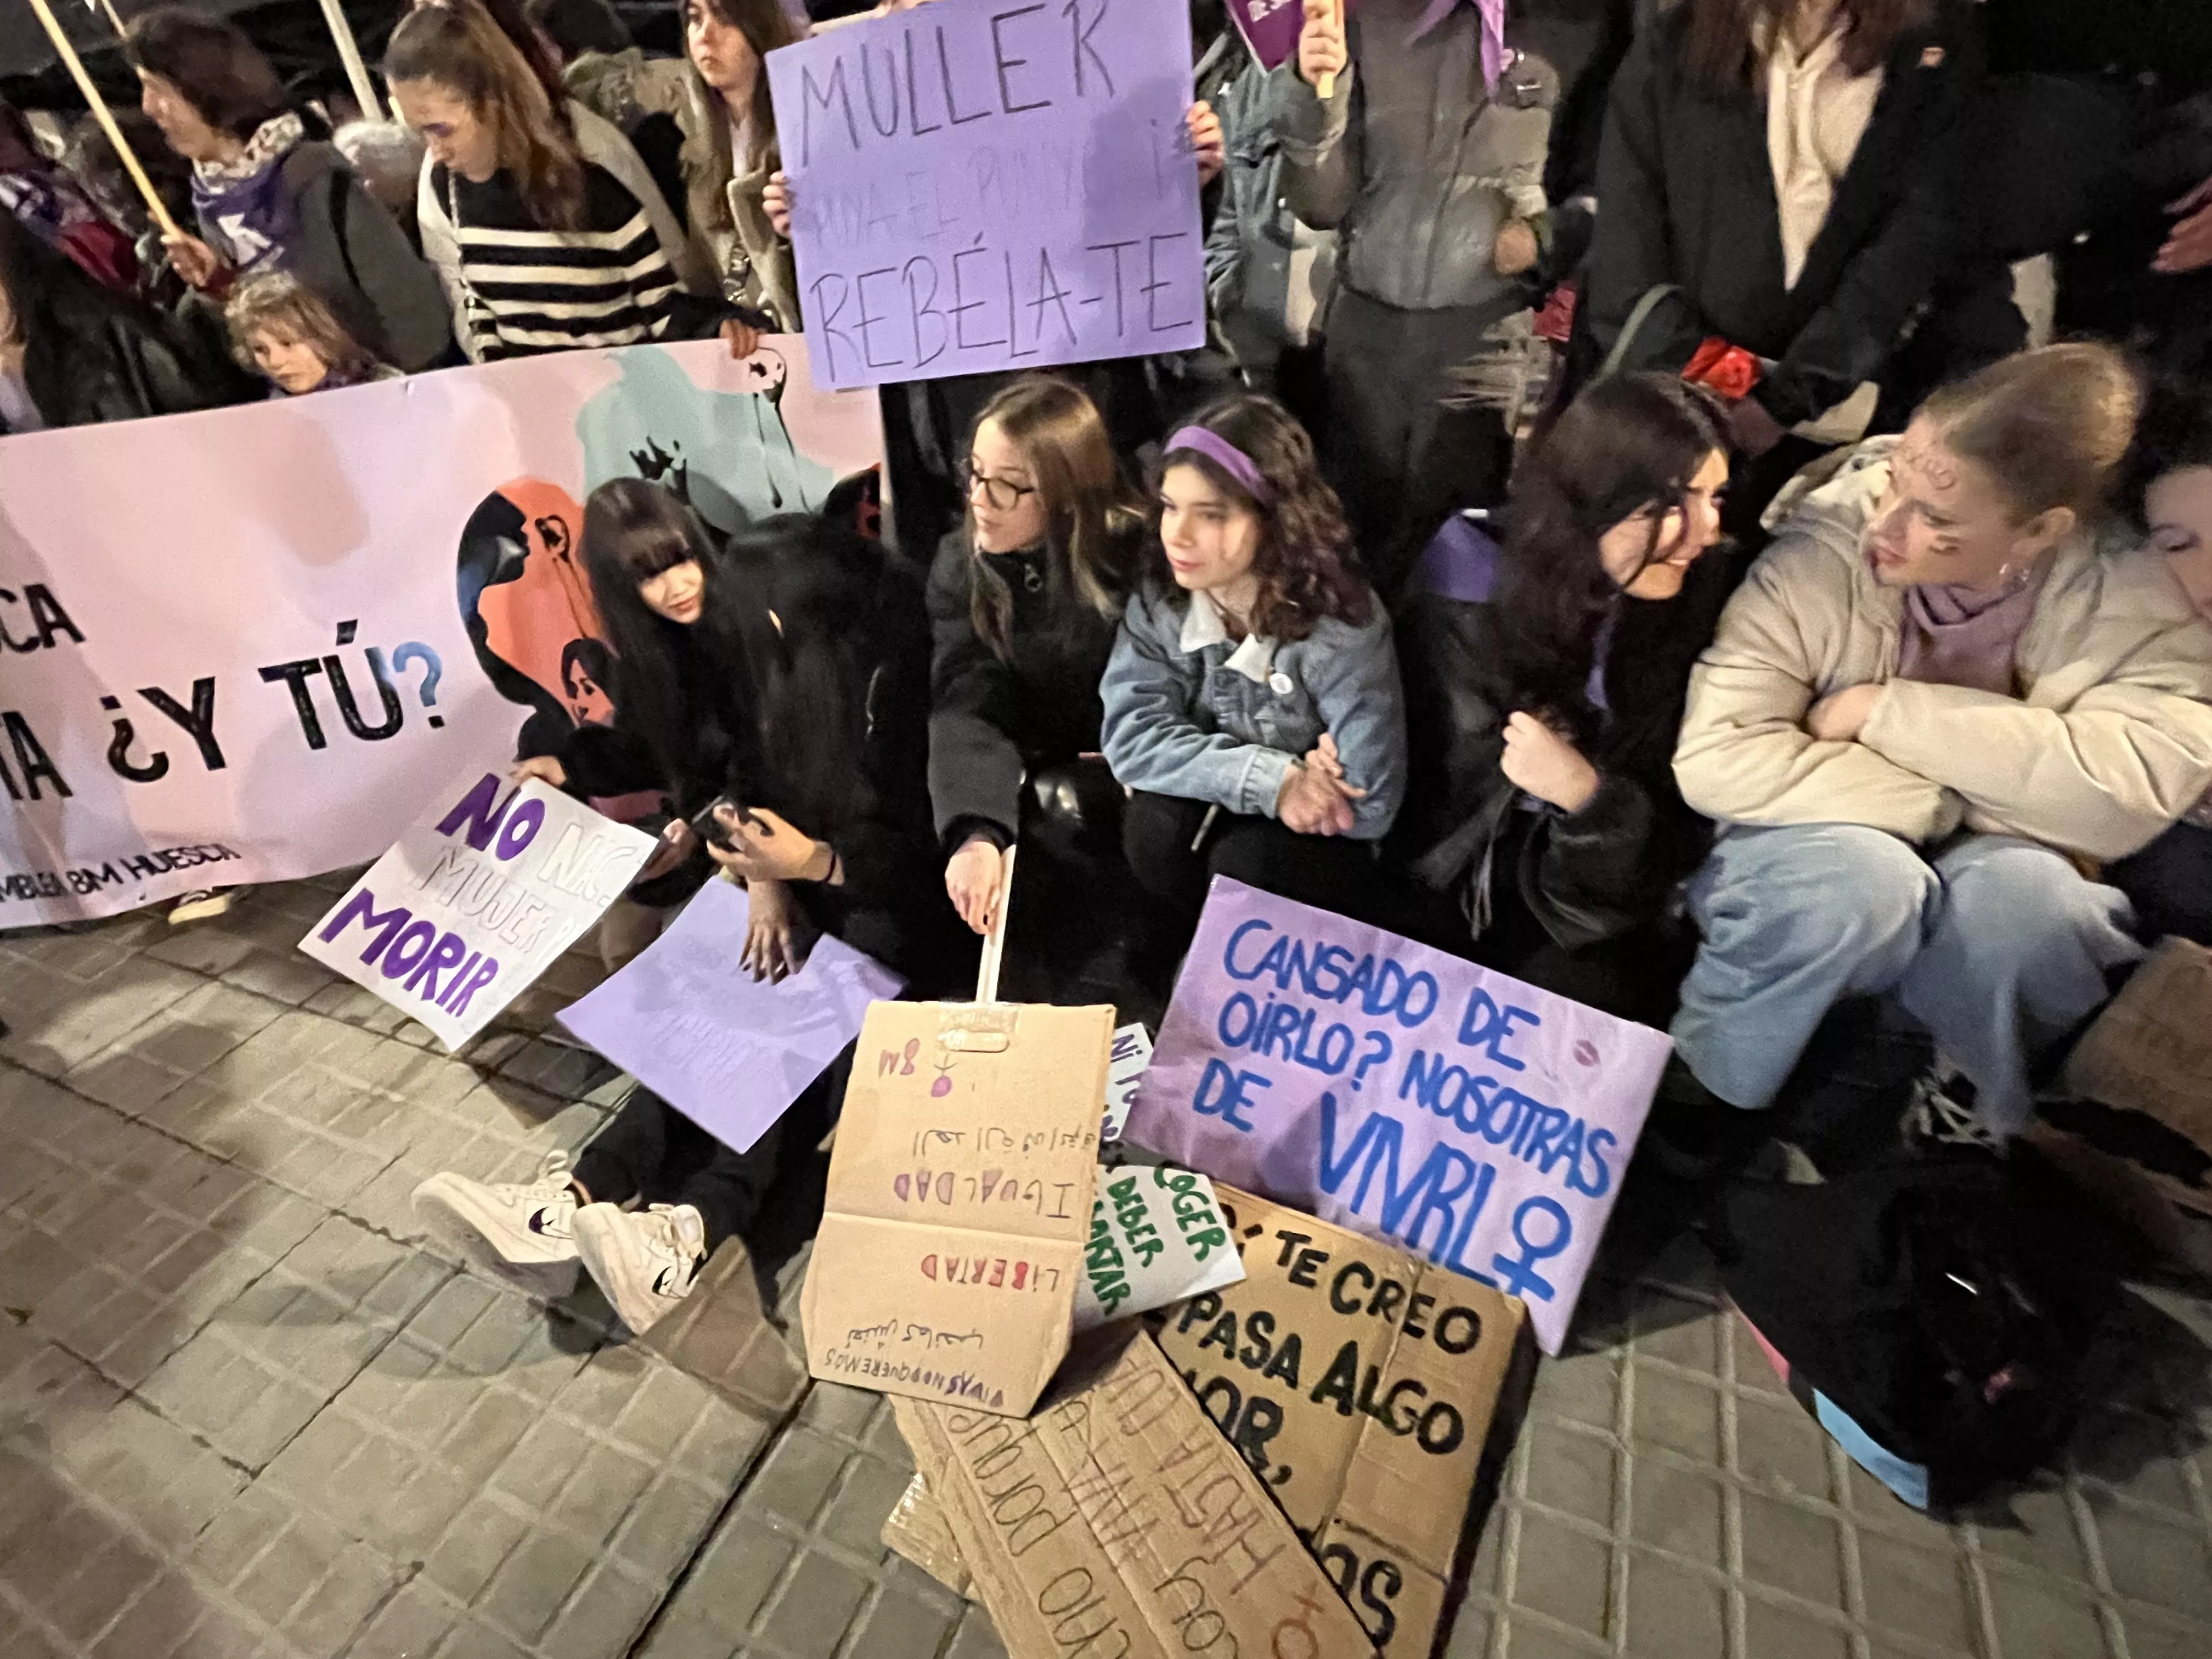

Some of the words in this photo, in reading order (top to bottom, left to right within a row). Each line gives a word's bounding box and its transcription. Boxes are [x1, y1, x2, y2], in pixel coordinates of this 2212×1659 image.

[802, 0, 1115, 167] MULLER
[810, 232, 1192, 381] REBÉLA-TE
[99, 676, 227, 782] ¿Y
[258, 618, 445, 751] TÚ?
[66, 862, 124, 894] 8M
[121, 844, 241, 879] HUESCA
[435, 773, 545, 861] NO
[318, 888, 498, 1017] MORIR
[411, 845, 555, 951] MUJER
[879, 1038, 921, 1078] 8M
[1223, 919, 1437, 1027] CANSADO
[1458, 989, 1539, 1071] DE
[1193, 1059, 1272, 1132] DE
[1400, 1051, 1617, 1198] NOSOTRAS
[894, 1169, 1076, 1218] IGUALDAD
[1277, 1230, 1329, 1286] TE
[1330, 1261, 1481, 1354] CREO
[1176, 1290, 1303, 1386] PASA
[1310, 1340, 1465, 1456] ALGO
[949, 1411, 1077, 1558] porque
[1158, 1429, 1286, 1593] HASTA
